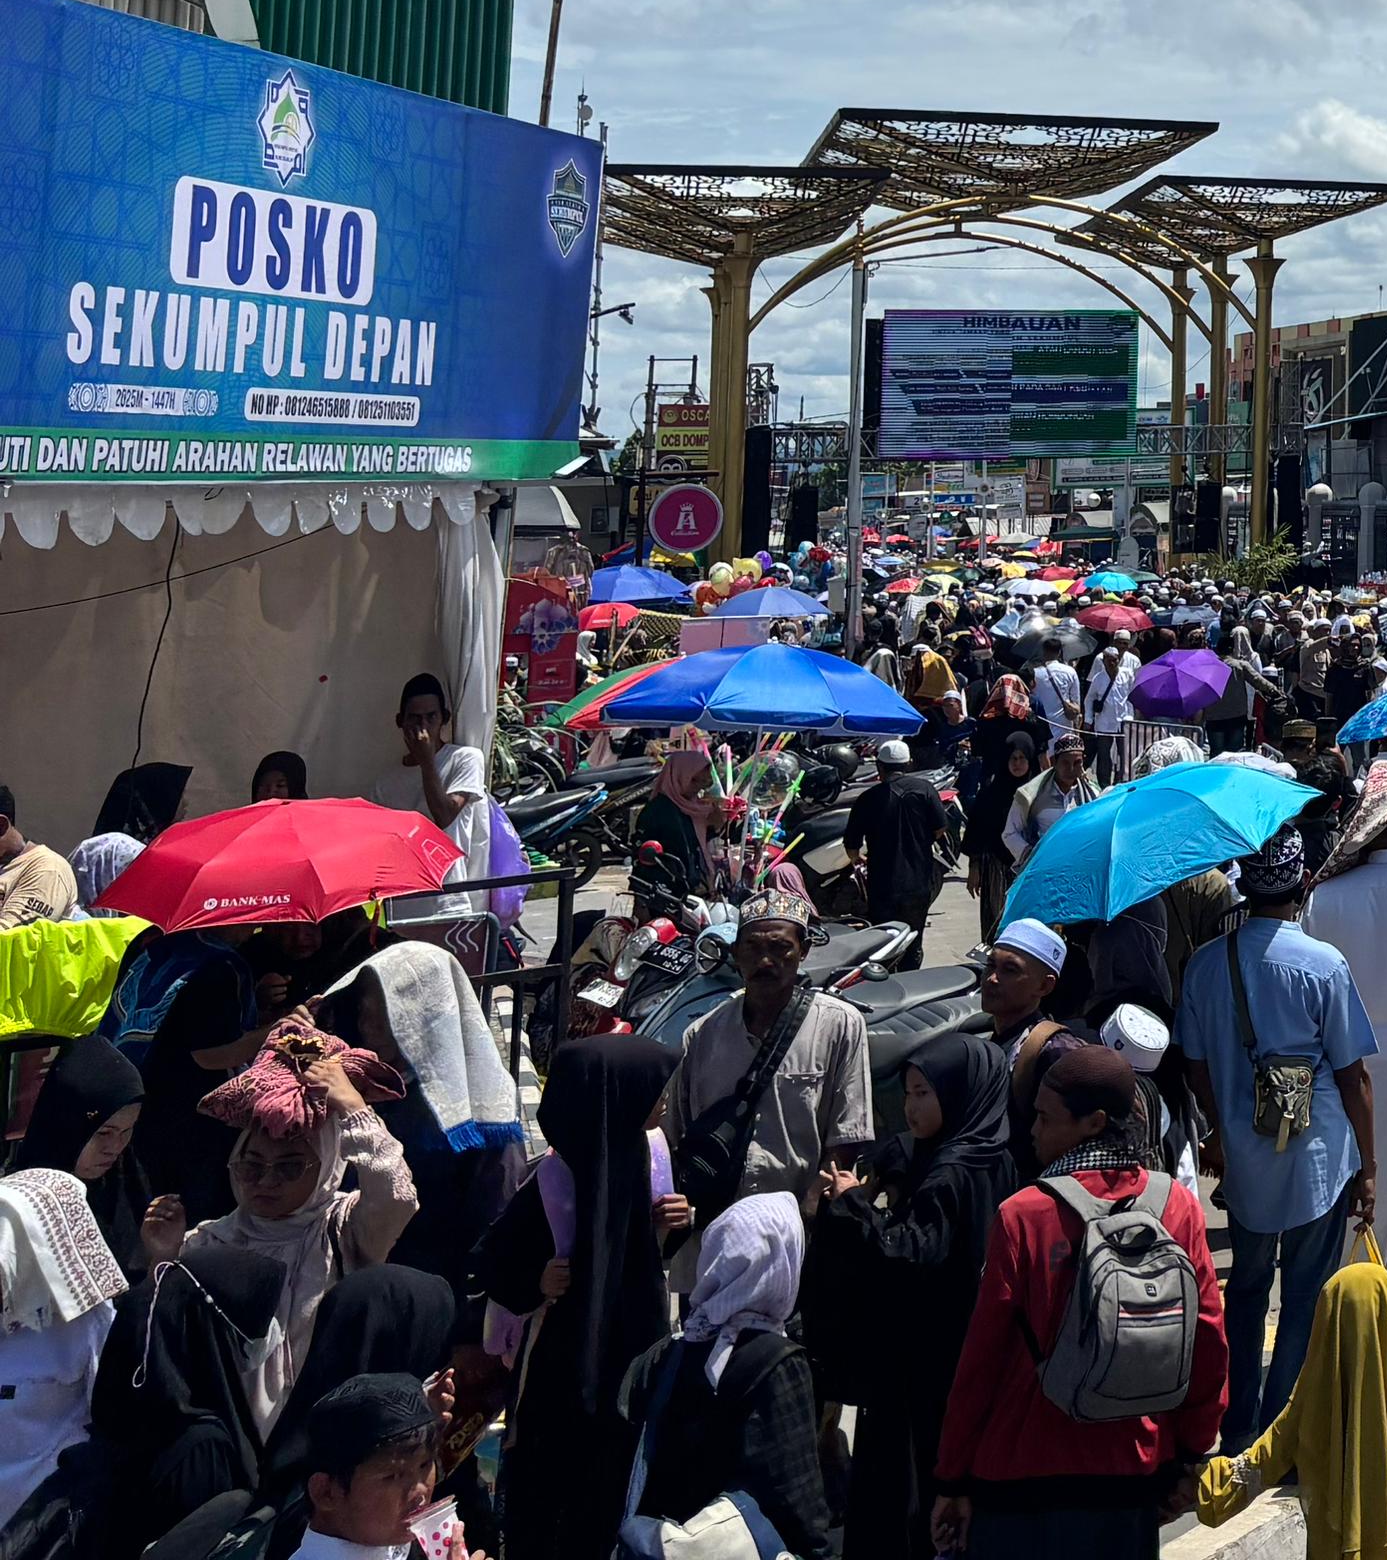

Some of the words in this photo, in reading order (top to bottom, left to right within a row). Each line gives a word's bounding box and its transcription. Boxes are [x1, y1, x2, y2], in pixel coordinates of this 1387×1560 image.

[186, 184, 363, 299] POSKO
[66, 281, 306, 378] SEKUMPUL
[323, 311, 437, 386] DEPAN
[963, 316, 1081, 331] HIMBAUAN
[114, 388, 144, 410] 2025M
[150, 392, 176, 410] 1447H
[250, 393, 264, 414] NO
[266, 395, 280, 415] HP
[661, 434, 681, 447] OCB
[36, 436, 87, 473] DAN
[93, 438, 169, 473] PATUHI
[172, 440, 257, 473] ARAHAN
[261, 442, 347, 474] RELAWAN
[347, 443, 394, 474] YANG
[395, 445, 472, 474] BERTUGAS
[220, 896, 258, 907] BANK
[261, 894, 291, 905] MAS
